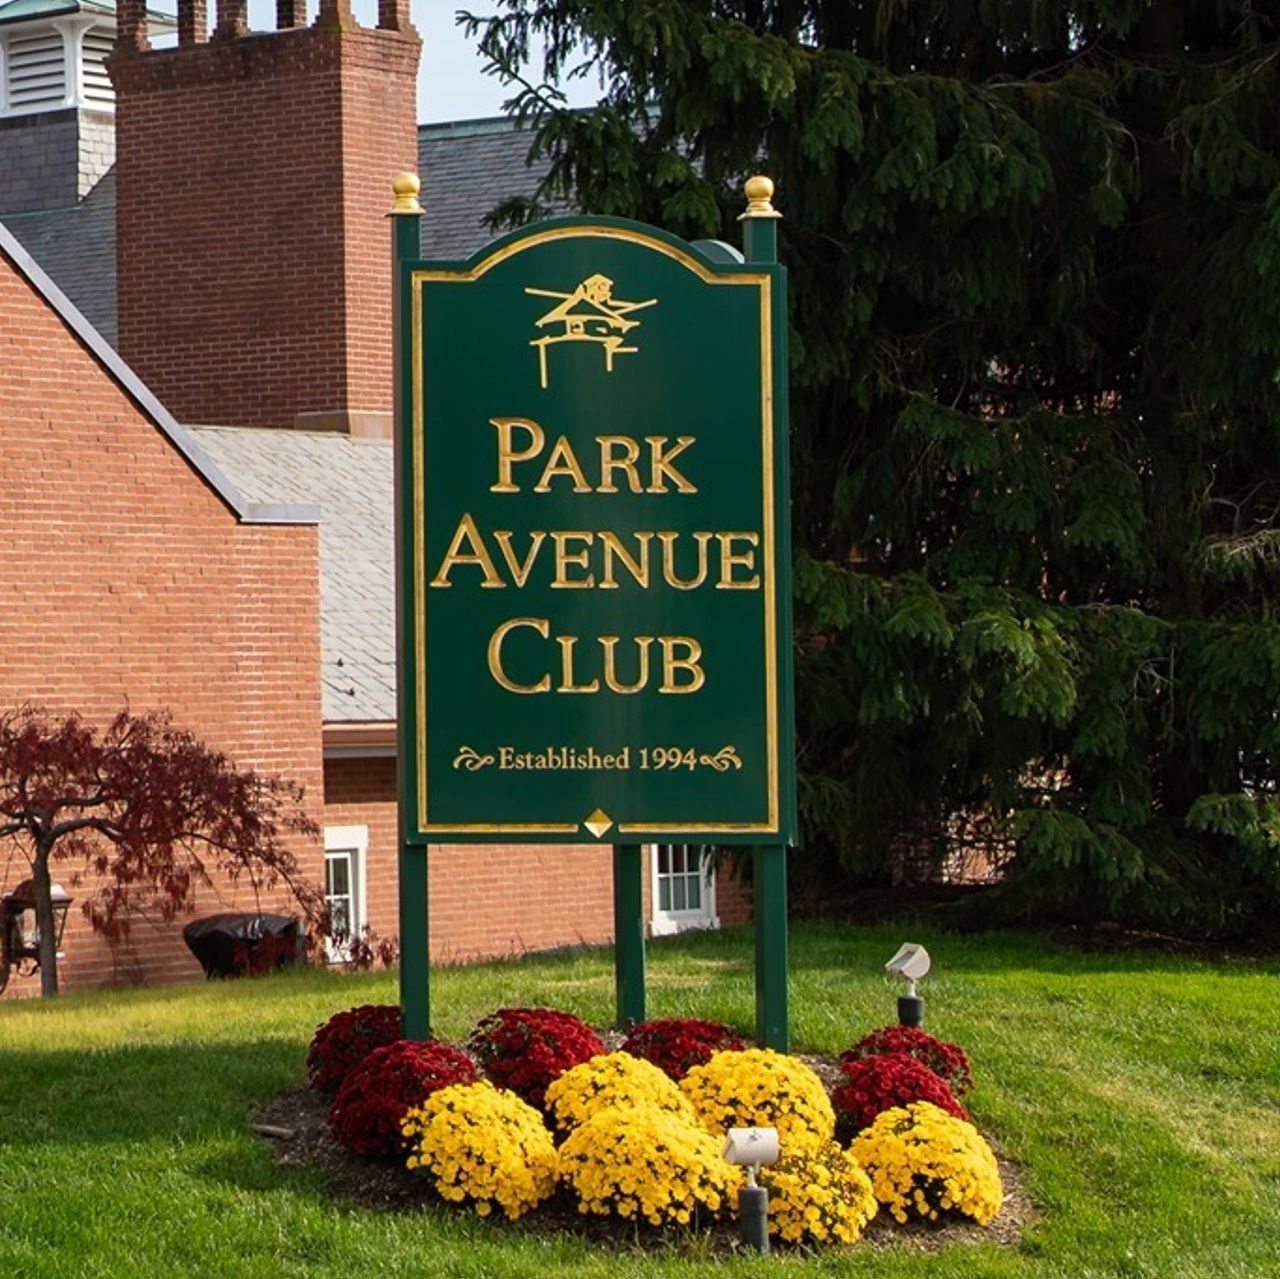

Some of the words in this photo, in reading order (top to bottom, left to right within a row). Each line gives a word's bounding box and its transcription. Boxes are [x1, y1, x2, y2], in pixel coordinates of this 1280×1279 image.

[489, 417, 698, 494] PARK
[429, 513, 761, 590] AVENUE
[487, 618, 706, 695] CLUB
[498, 746, 630, 770] Established
[639, 746, 697, 771] 1994
